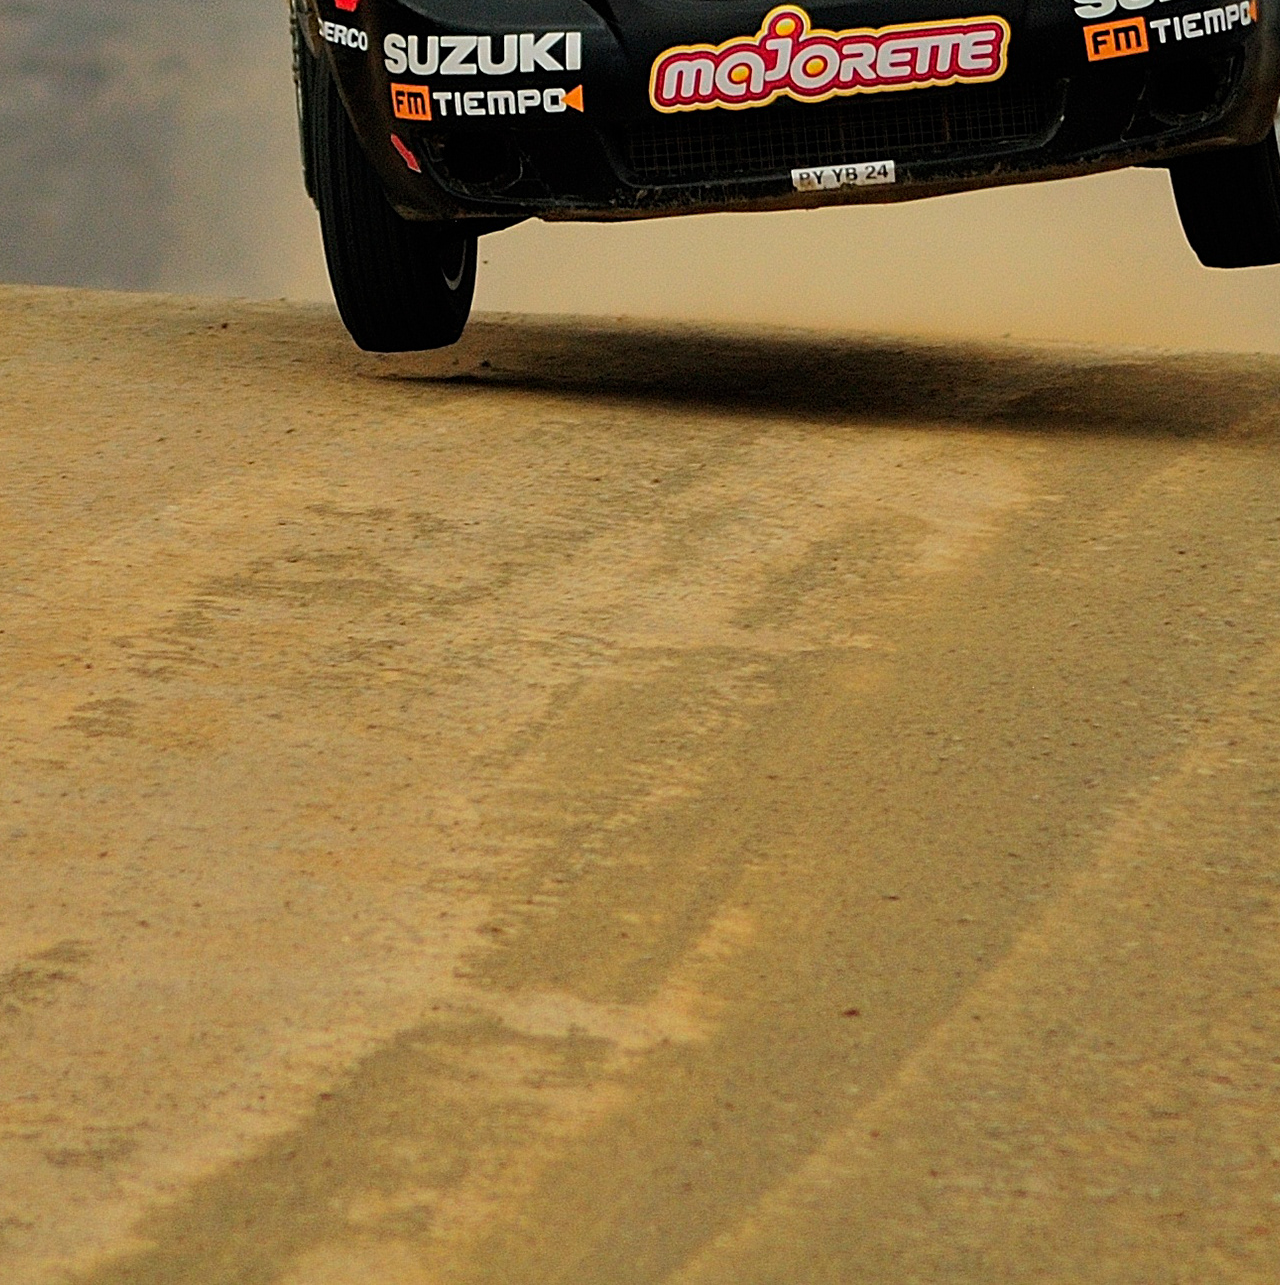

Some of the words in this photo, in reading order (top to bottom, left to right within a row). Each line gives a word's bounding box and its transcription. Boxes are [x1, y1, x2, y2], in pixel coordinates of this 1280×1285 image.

[1149, 0, 1252, 44] TIEMPO
[383, 32, 582, 76] SUZUKI
[433, 87, 568, 116] TIEMPO
[831, 167, 859, 183] YB
[864, 164, 889, 180] 24
